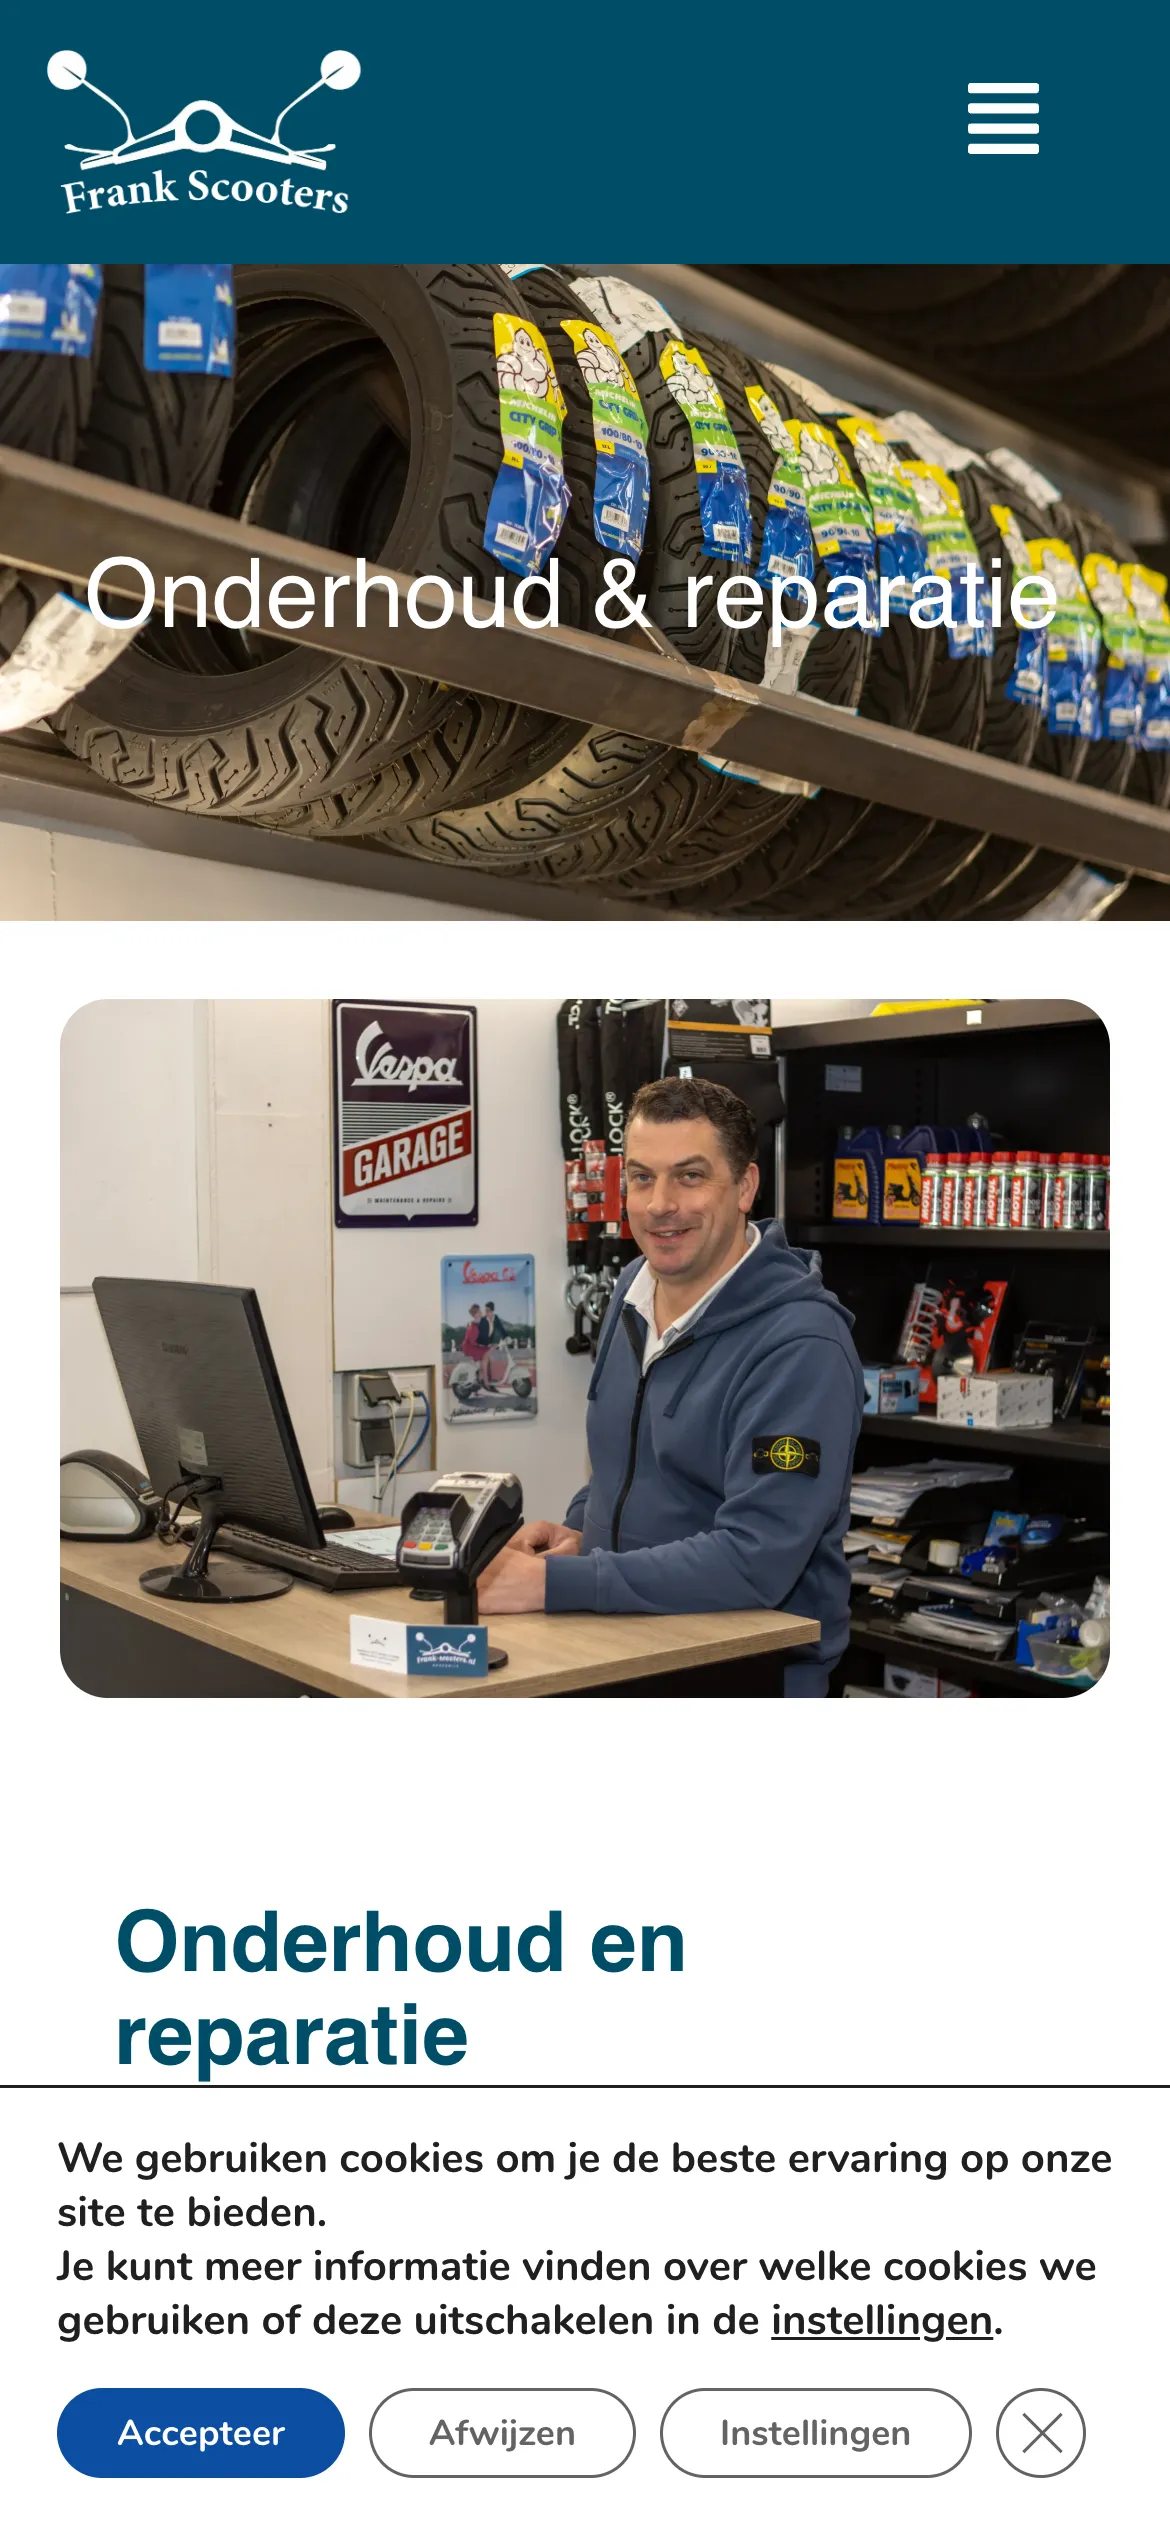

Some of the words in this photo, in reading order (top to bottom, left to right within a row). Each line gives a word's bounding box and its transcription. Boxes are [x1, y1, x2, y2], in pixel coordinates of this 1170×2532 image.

[595, 389, 636, 408] MICHELIN
[509, 411, 536, 425] CITY
[538, 420, 557, 437] GRIP
[351, 1020, 464, 1093] Vespa
[354, 1119, 464, 1188] GARAGE
[921, 1179, 932, 1220] MOTUL
[942, 1180, 953, 1222] MOTUL
[964, 1180, 974, 1221] MOTUL
[987, 1179, 998, 1220] MOTUL
[1011, 1180, 1022, 1222] MOTUL
[1054, 1181, 1064, 1223] MOTUL
